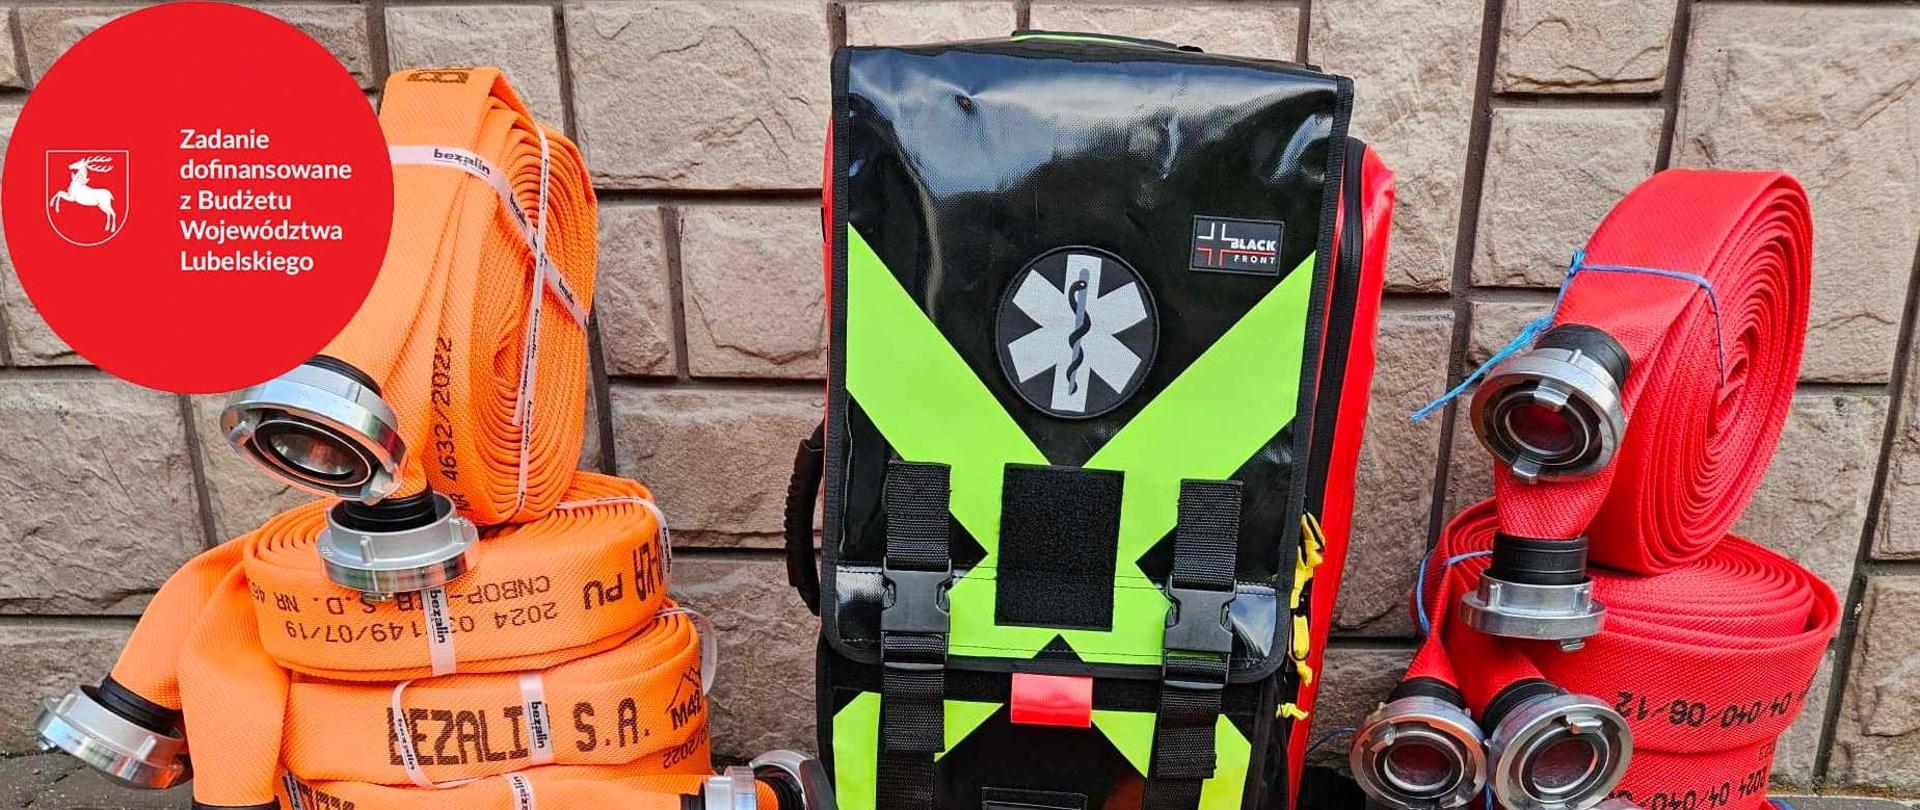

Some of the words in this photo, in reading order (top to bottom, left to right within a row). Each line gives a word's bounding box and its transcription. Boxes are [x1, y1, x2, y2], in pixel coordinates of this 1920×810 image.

[434, 149, 490, 175] bezalin
[1230, 238, 1276, 251] BLACK
[1234, 255, 1275, 264] FRONT
[432, 336, 457, 481] 4632/2022
[273, 592, 299, 612] NR
[583, 573, 623, 609] PU
[429, 588, 449, 644] bezalin
[494, 601, 558, 629] 2024
[387, 704, 551, 765] BEZALI
[573, 697, 650, 752] S.A.
[531, 701, 548, 749] bezalin
